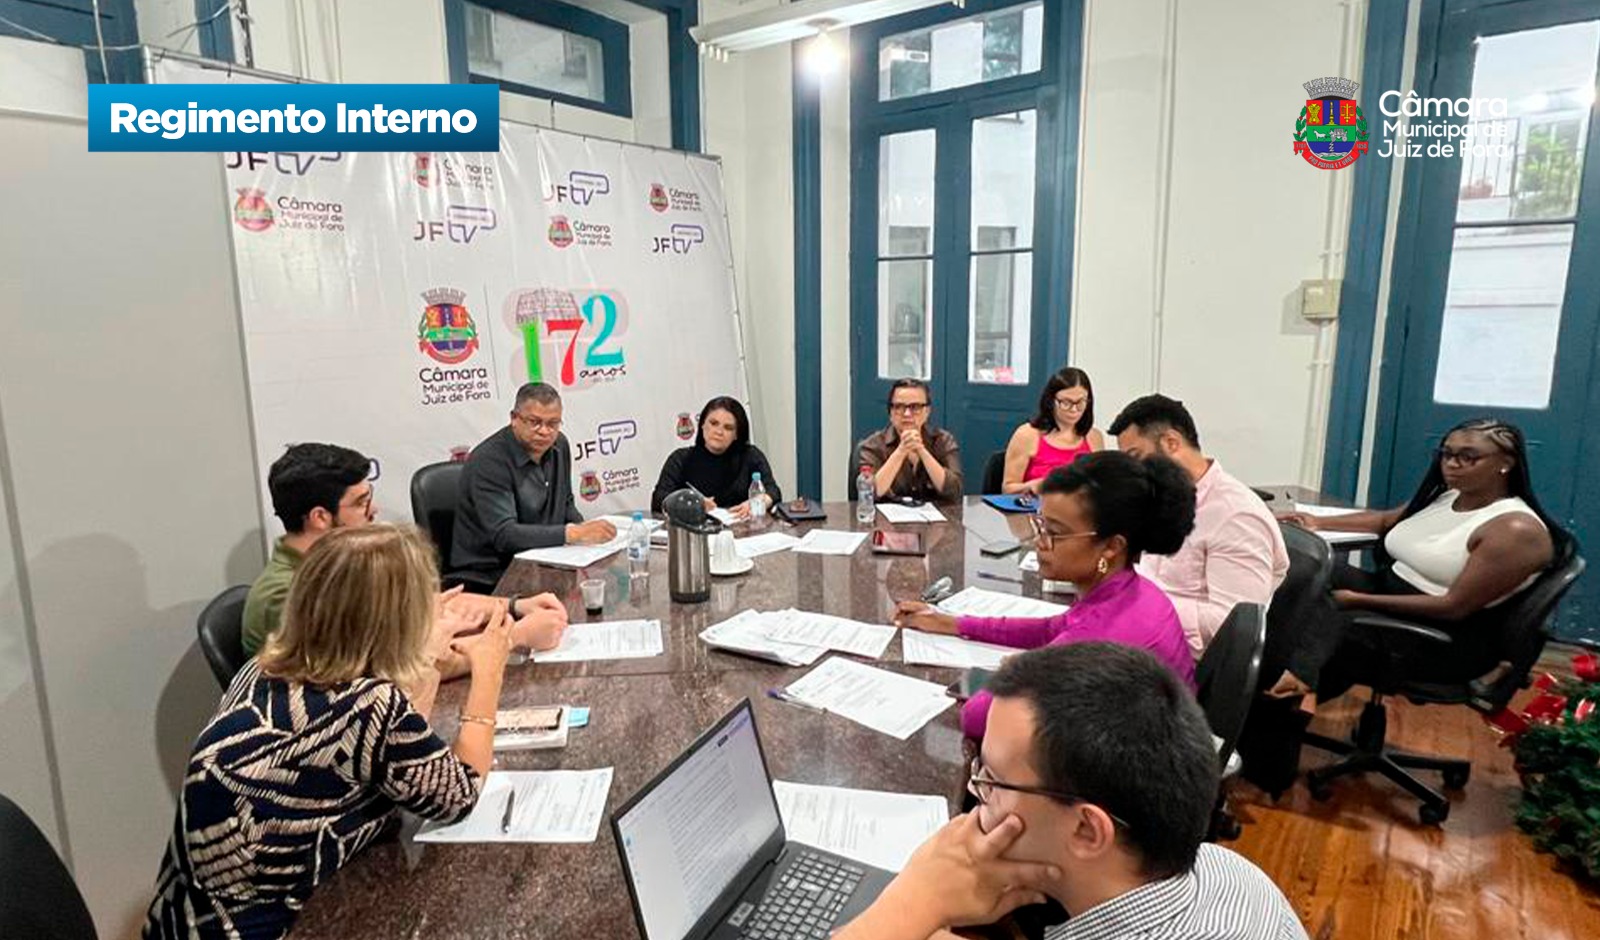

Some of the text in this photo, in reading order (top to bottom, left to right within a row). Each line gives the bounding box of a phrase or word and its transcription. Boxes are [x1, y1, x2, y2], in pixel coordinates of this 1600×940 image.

[277, 196, 342, 213] Câmara
[516, 294, 625, 386] 172
[419, 366, 487, 384] Câmara
[579, 364, 627, 379] anos
[423, 381, 489, 394] Municipal de
[421, 390, 491, 406] Juiz de Fora
